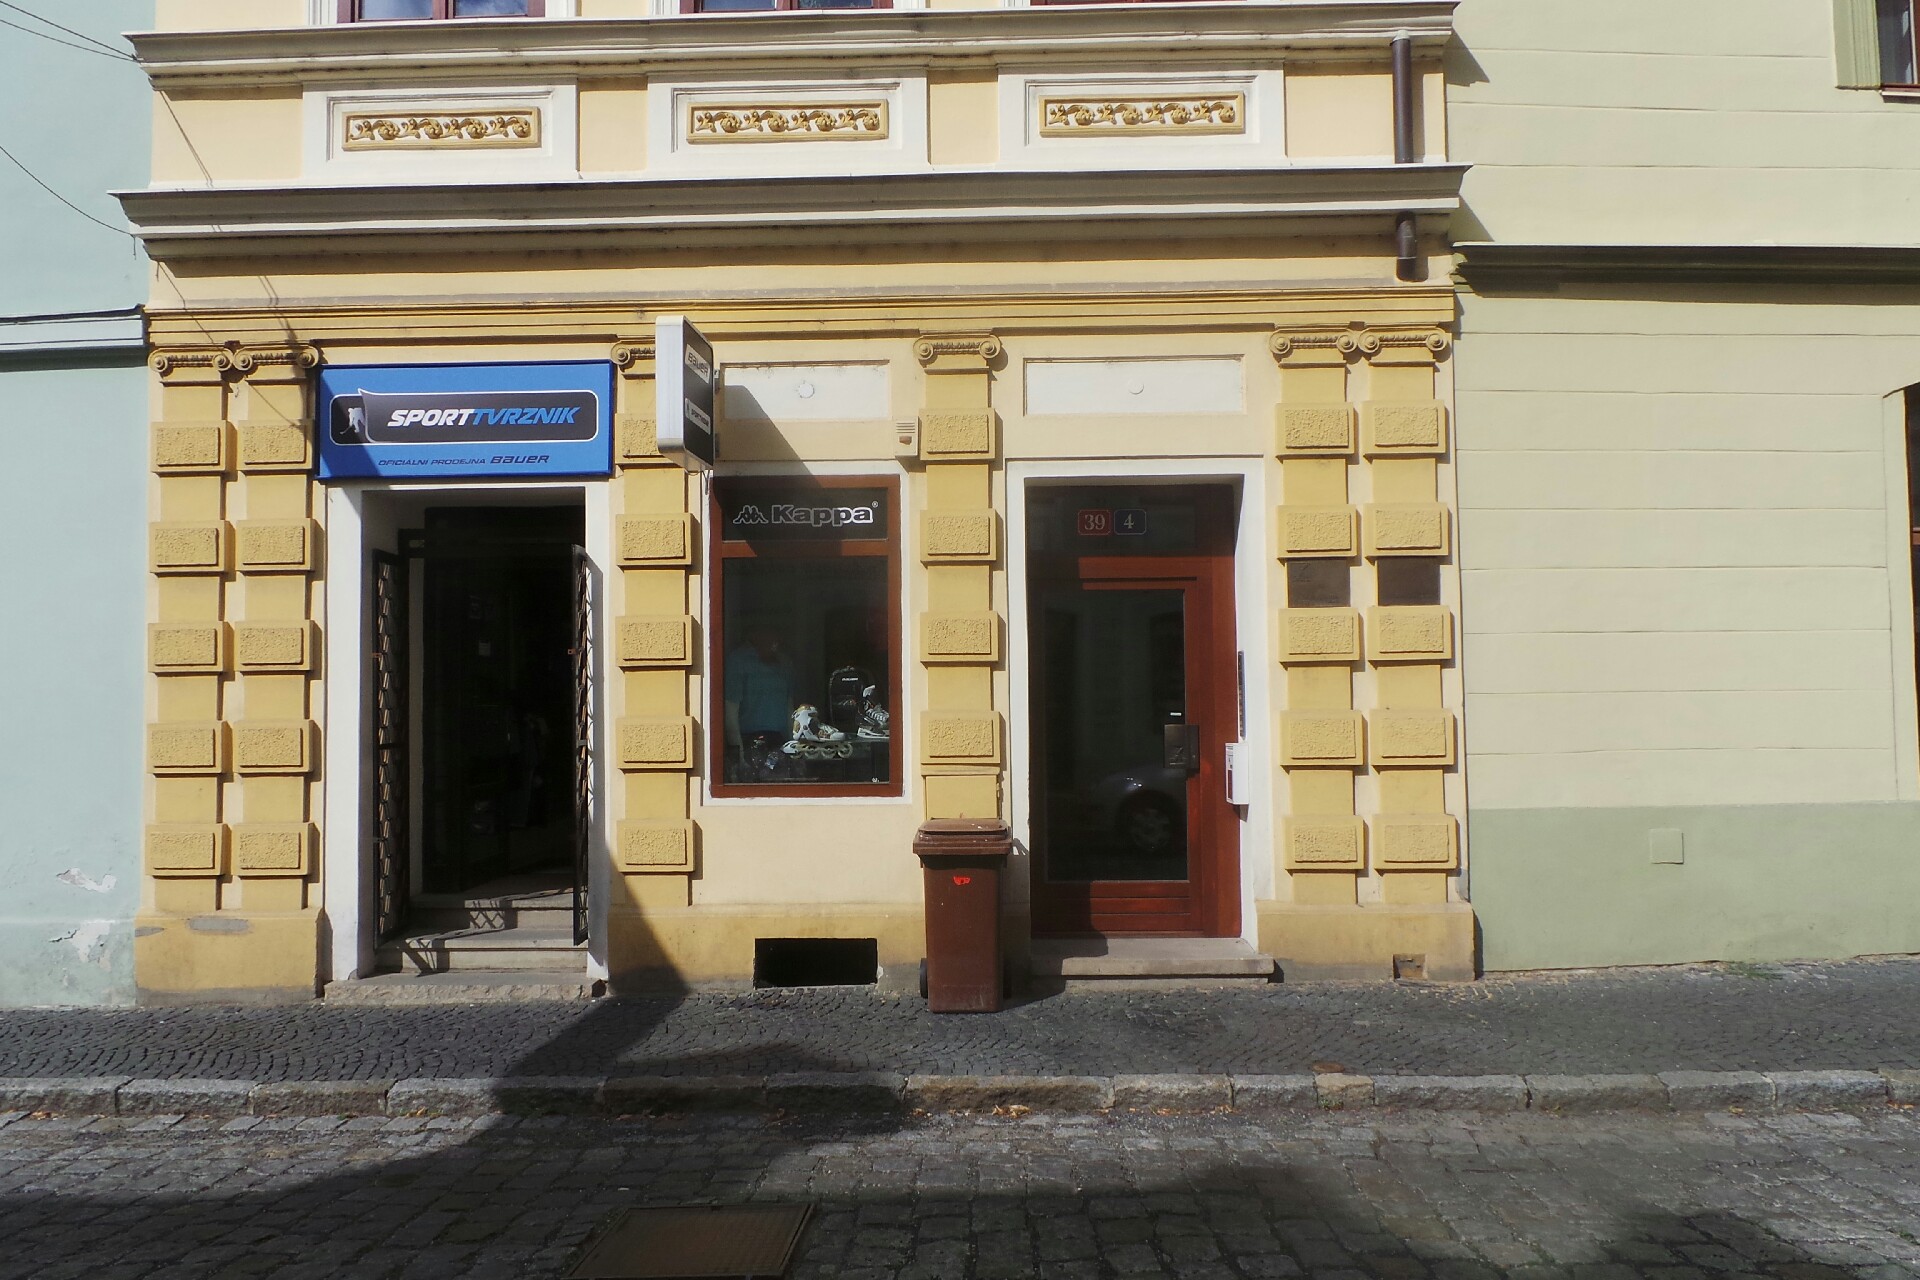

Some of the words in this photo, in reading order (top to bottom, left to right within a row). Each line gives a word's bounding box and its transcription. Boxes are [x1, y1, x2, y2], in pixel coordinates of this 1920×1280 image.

[387, 407, 581, 427] SPORTTVRZNIK
[430, 458, 486, 466] PRODEJNA
[771, 504, 874, 527] Kappa
[1084, 514, 1106, 530] 39
[1123, 513, 1135, 529] 4
